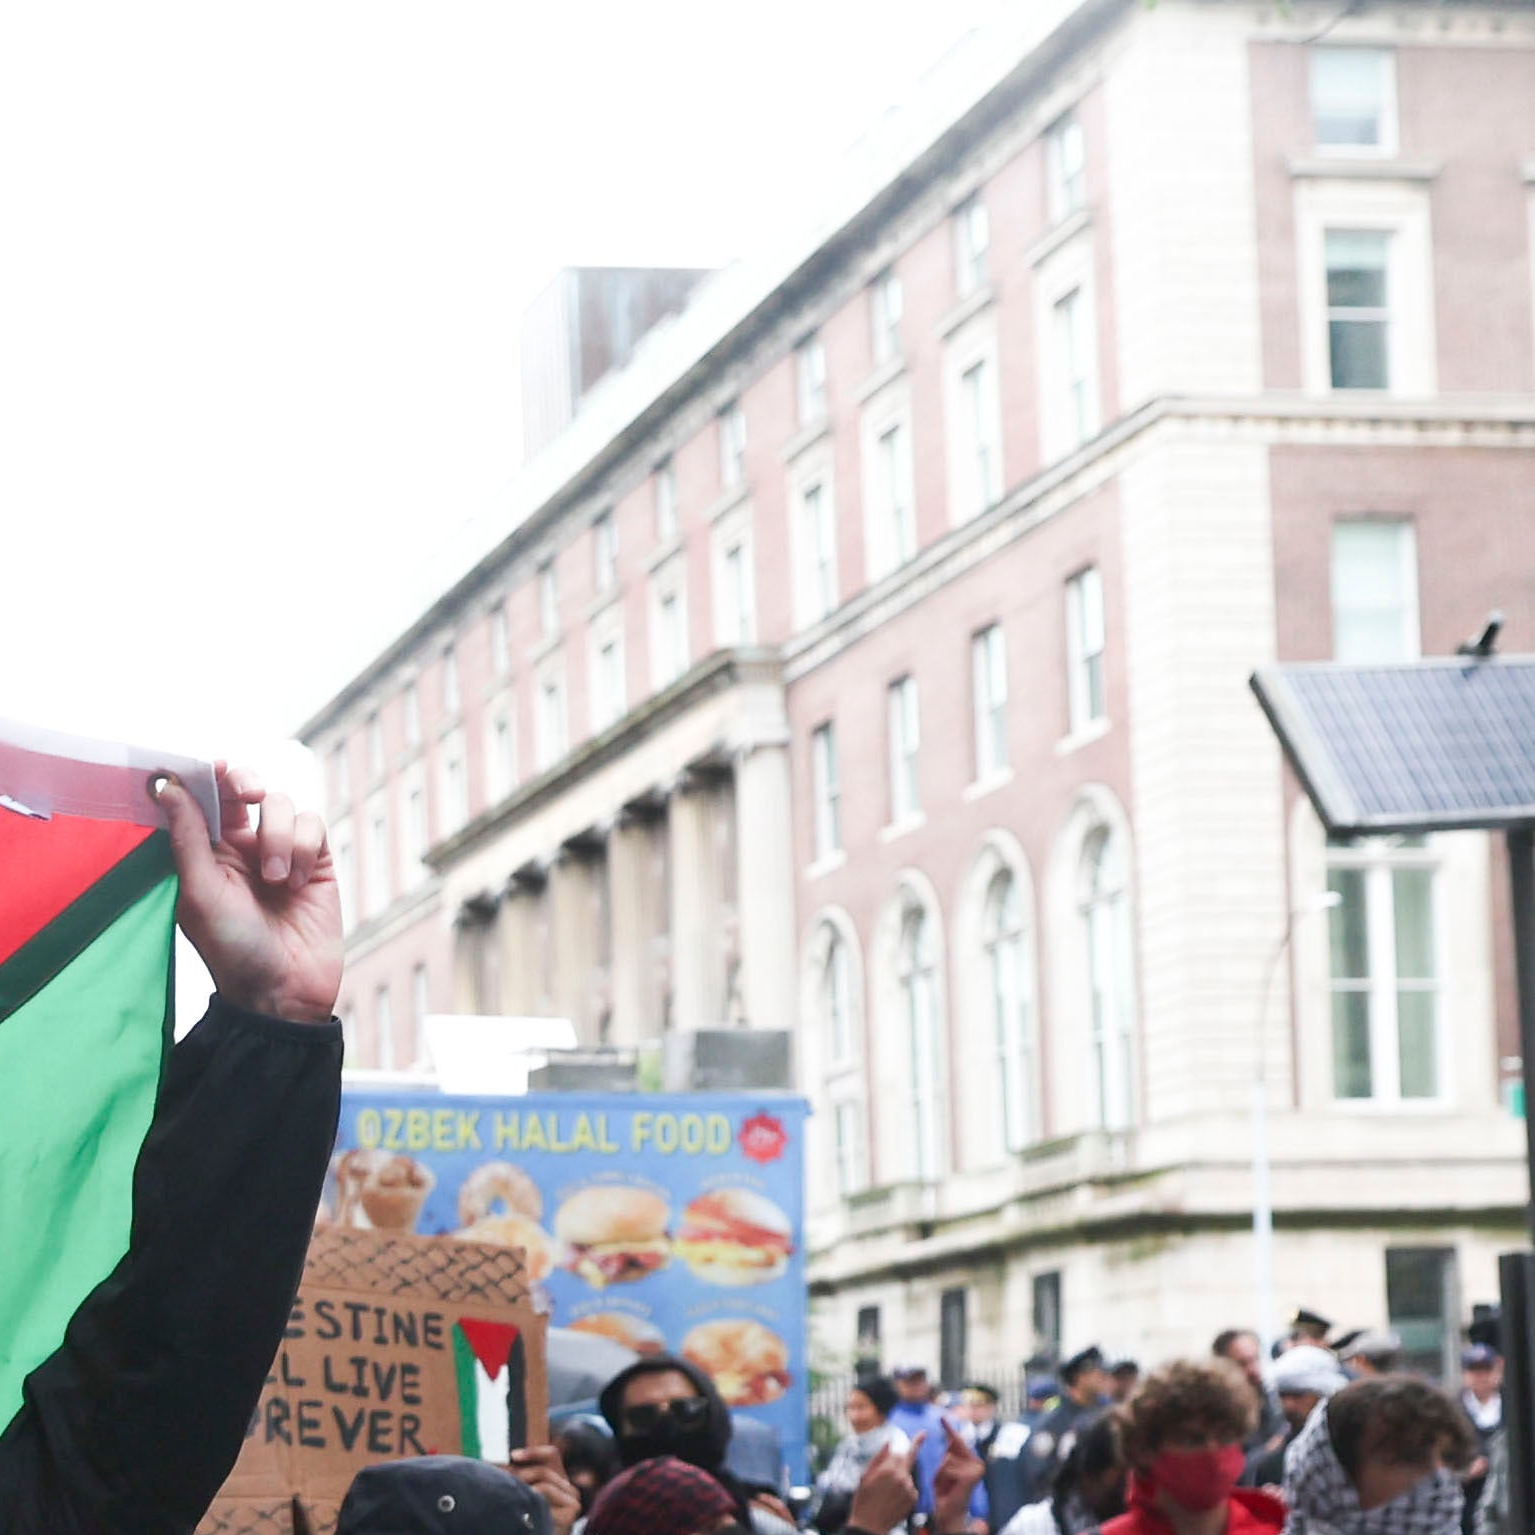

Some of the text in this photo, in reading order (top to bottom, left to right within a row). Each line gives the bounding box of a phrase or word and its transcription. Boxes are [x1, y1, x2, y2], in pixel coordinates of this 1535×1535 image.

[494, 1109, 619, 1153] HALAL
[632, 1112, 731, 1154] FOOD
[323, 1354, 422, 1405] LIVE
